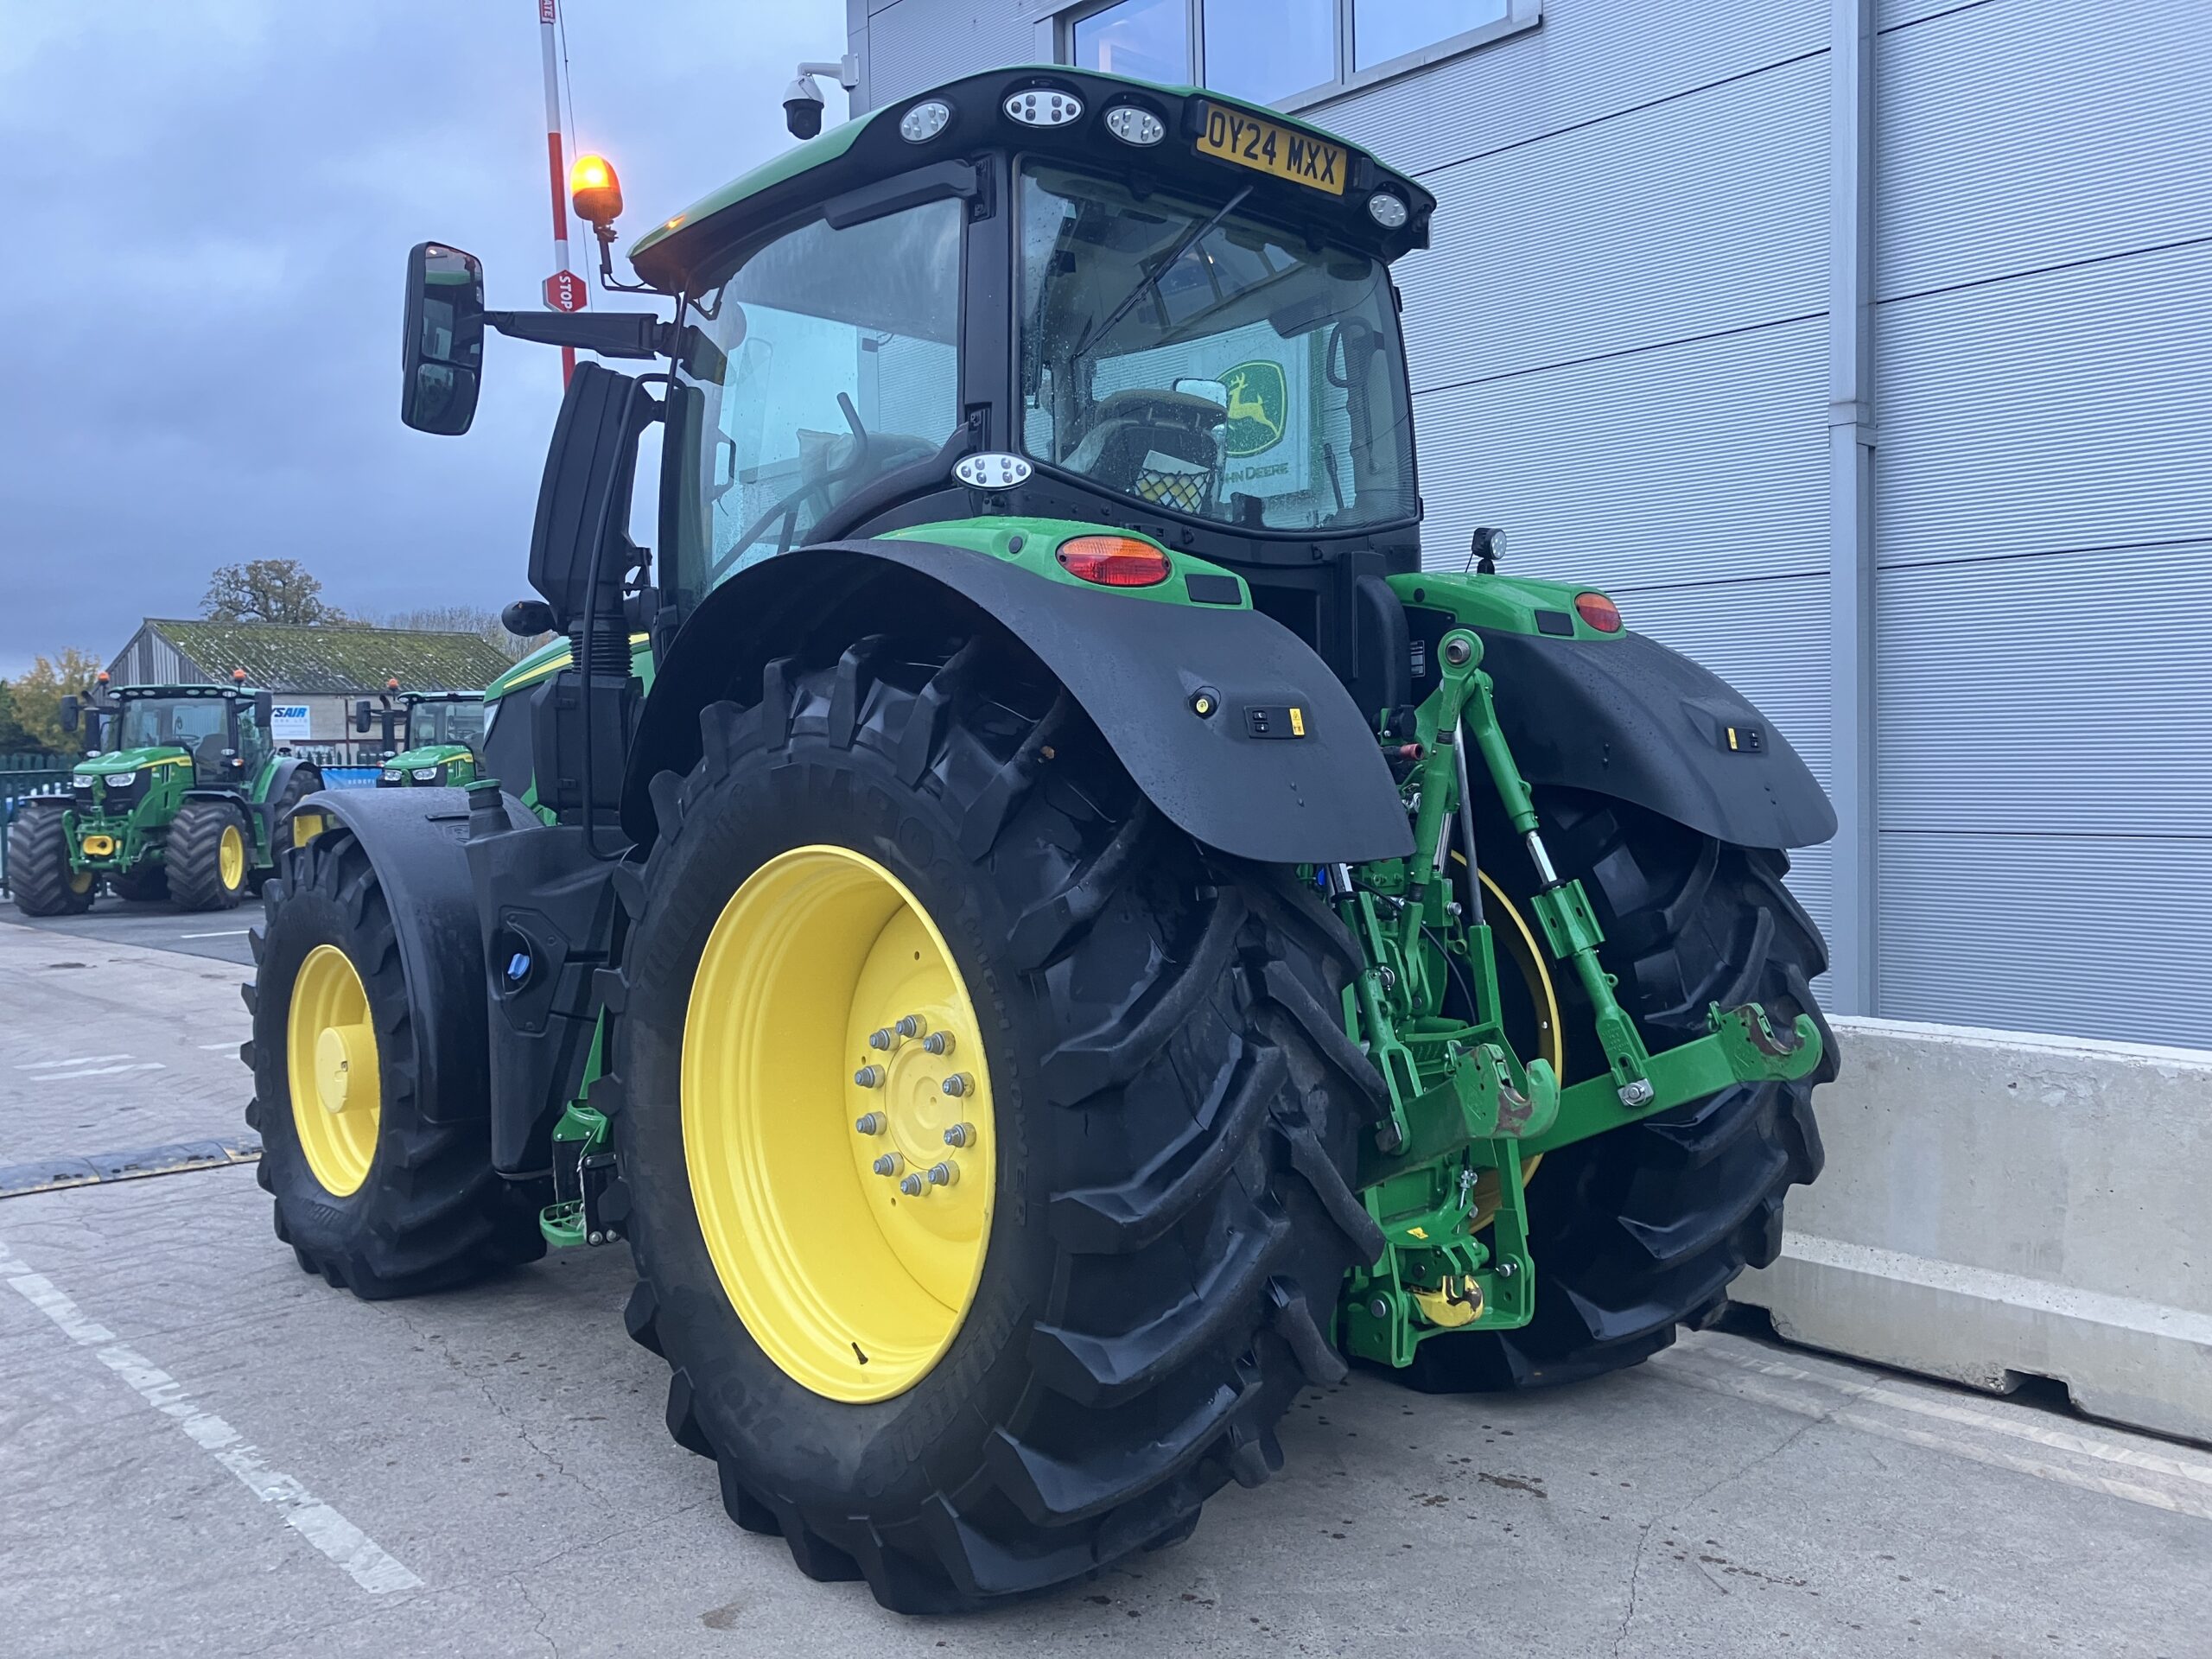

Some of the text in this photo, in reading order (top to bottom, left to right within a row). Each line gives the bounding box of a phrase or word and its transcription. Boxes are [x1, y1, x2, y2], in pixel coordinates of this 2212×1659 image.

[1208, 111, 1338, 185] OY24 MXX
[559, 276, 573, 309] STOP
[1246, 462, 1288, 480] DEERE
[1002, 1047, 1028, 1227] POWER
